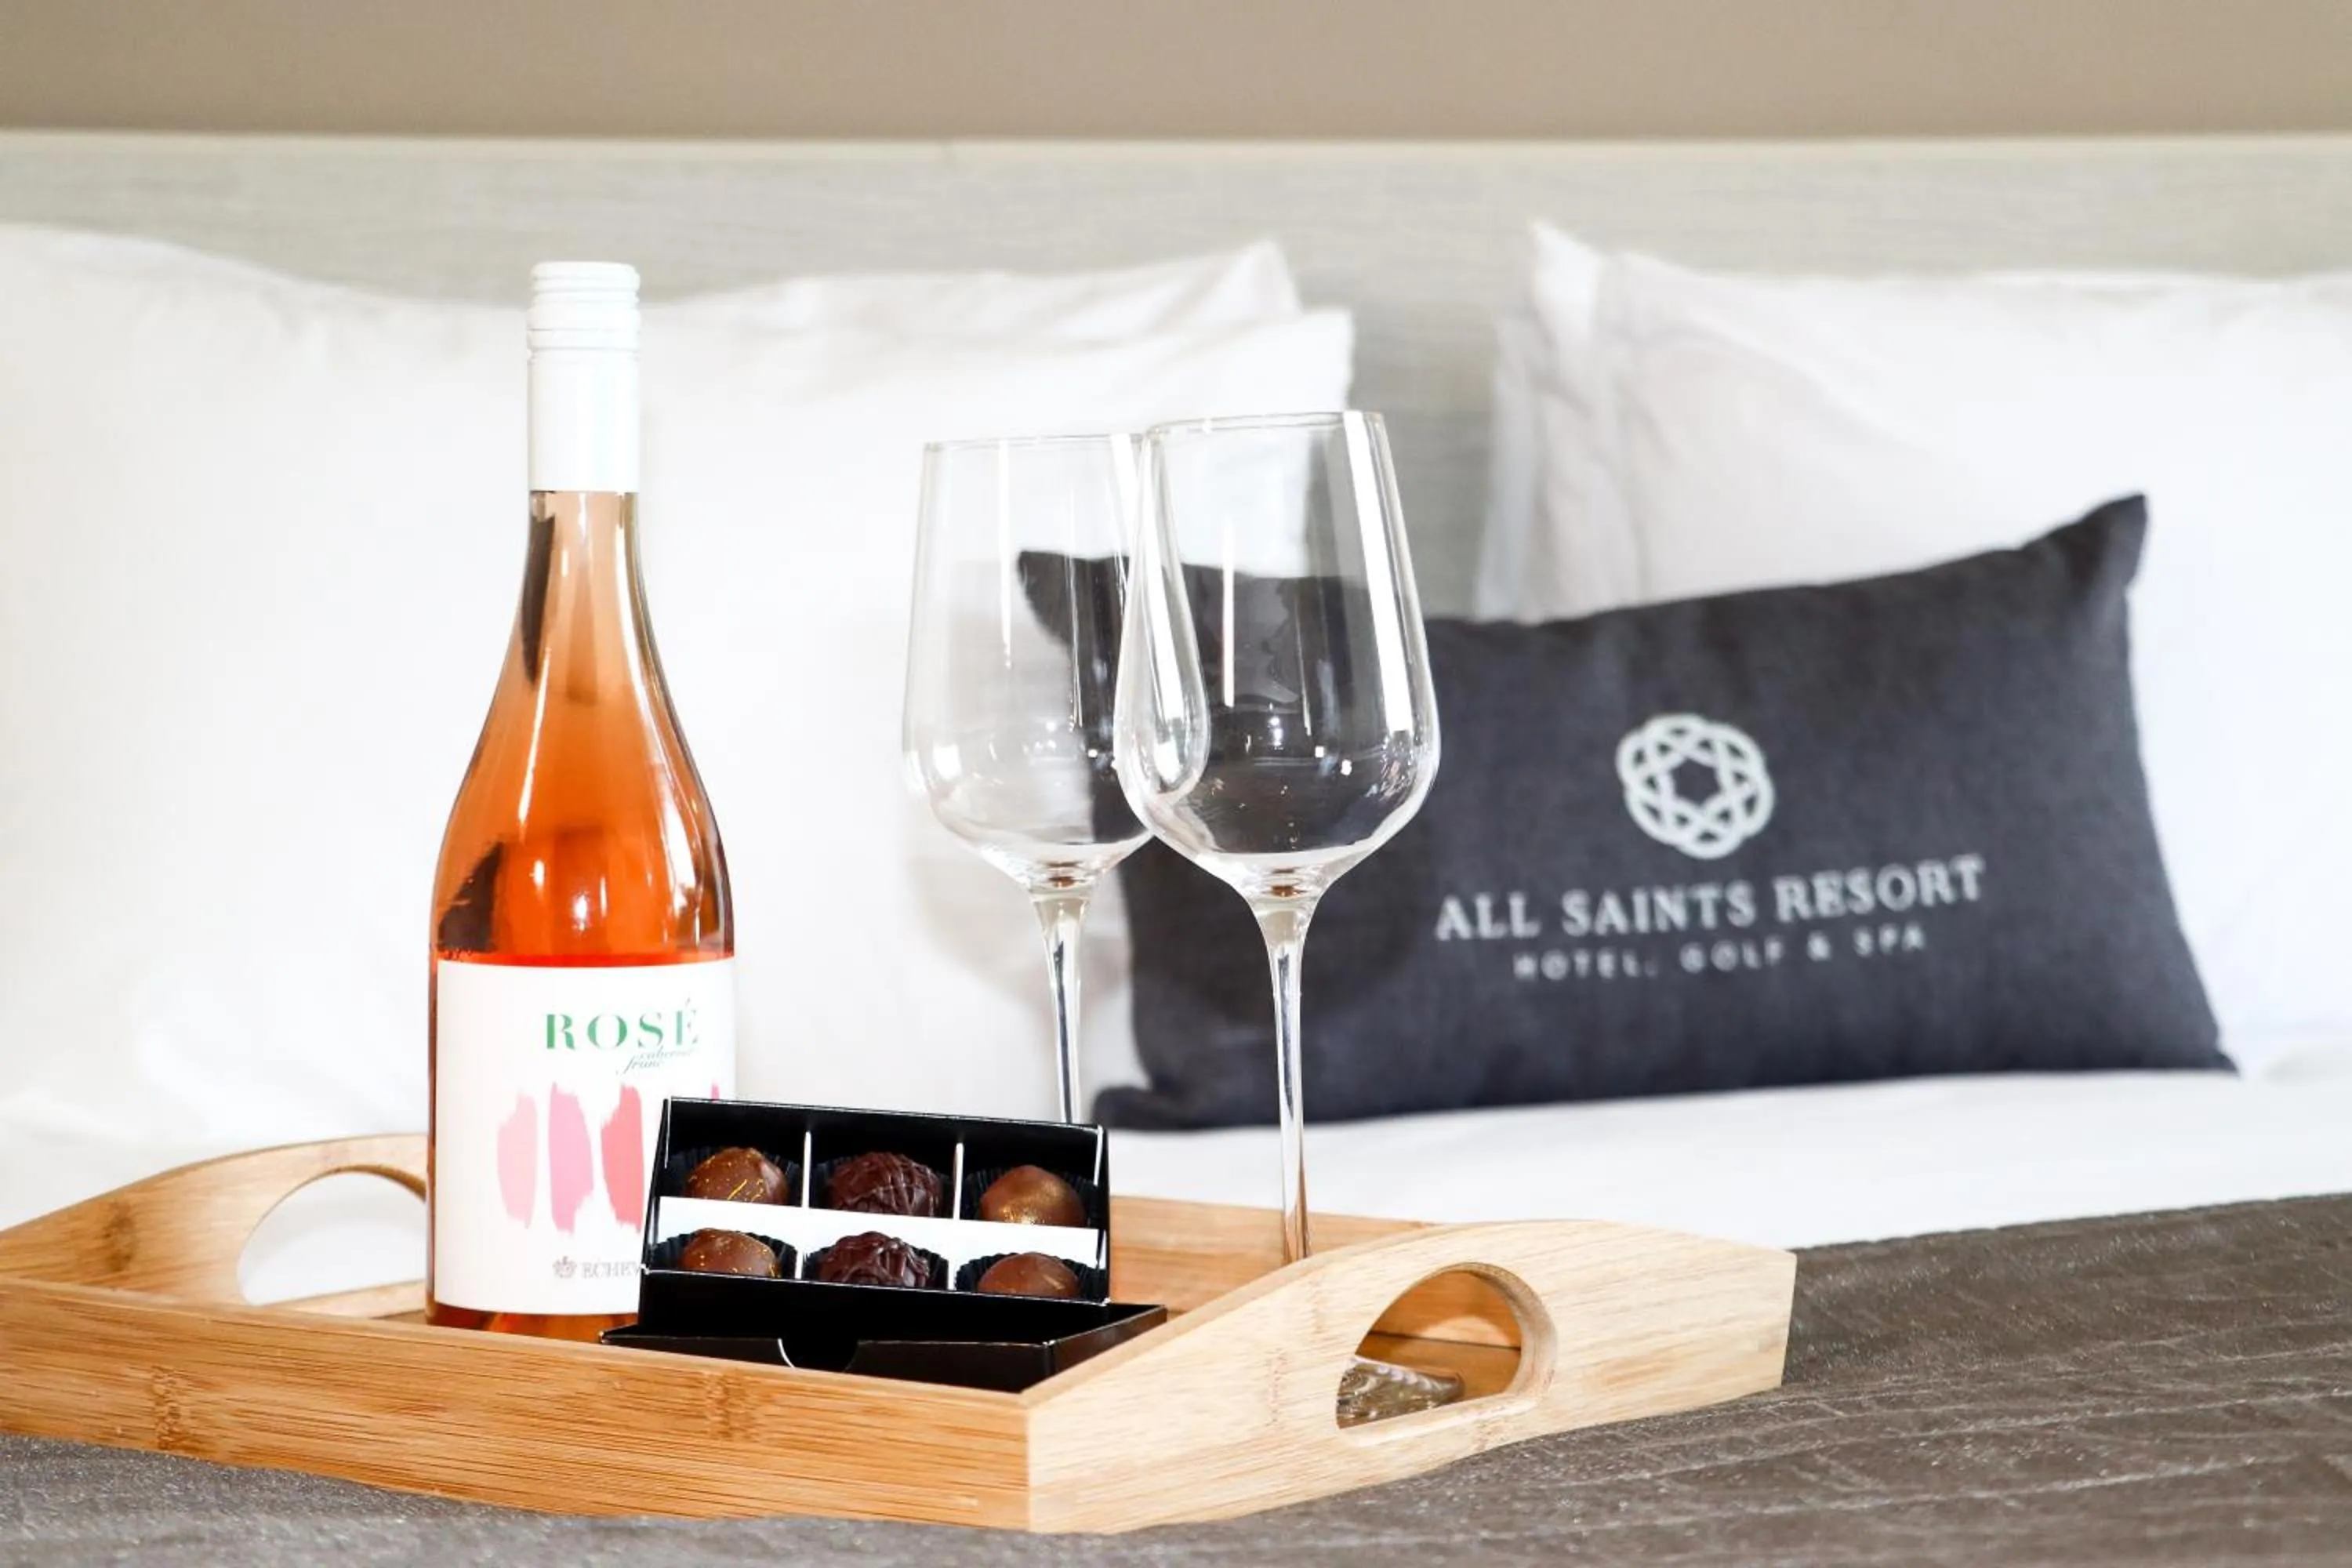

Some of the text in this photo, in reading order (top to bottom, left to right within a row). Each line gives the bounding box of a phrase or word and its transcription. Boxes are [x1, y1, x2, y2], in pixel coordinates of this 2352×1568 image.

[1435, 852, 1984, 941] ALL SAINTS RESORT
